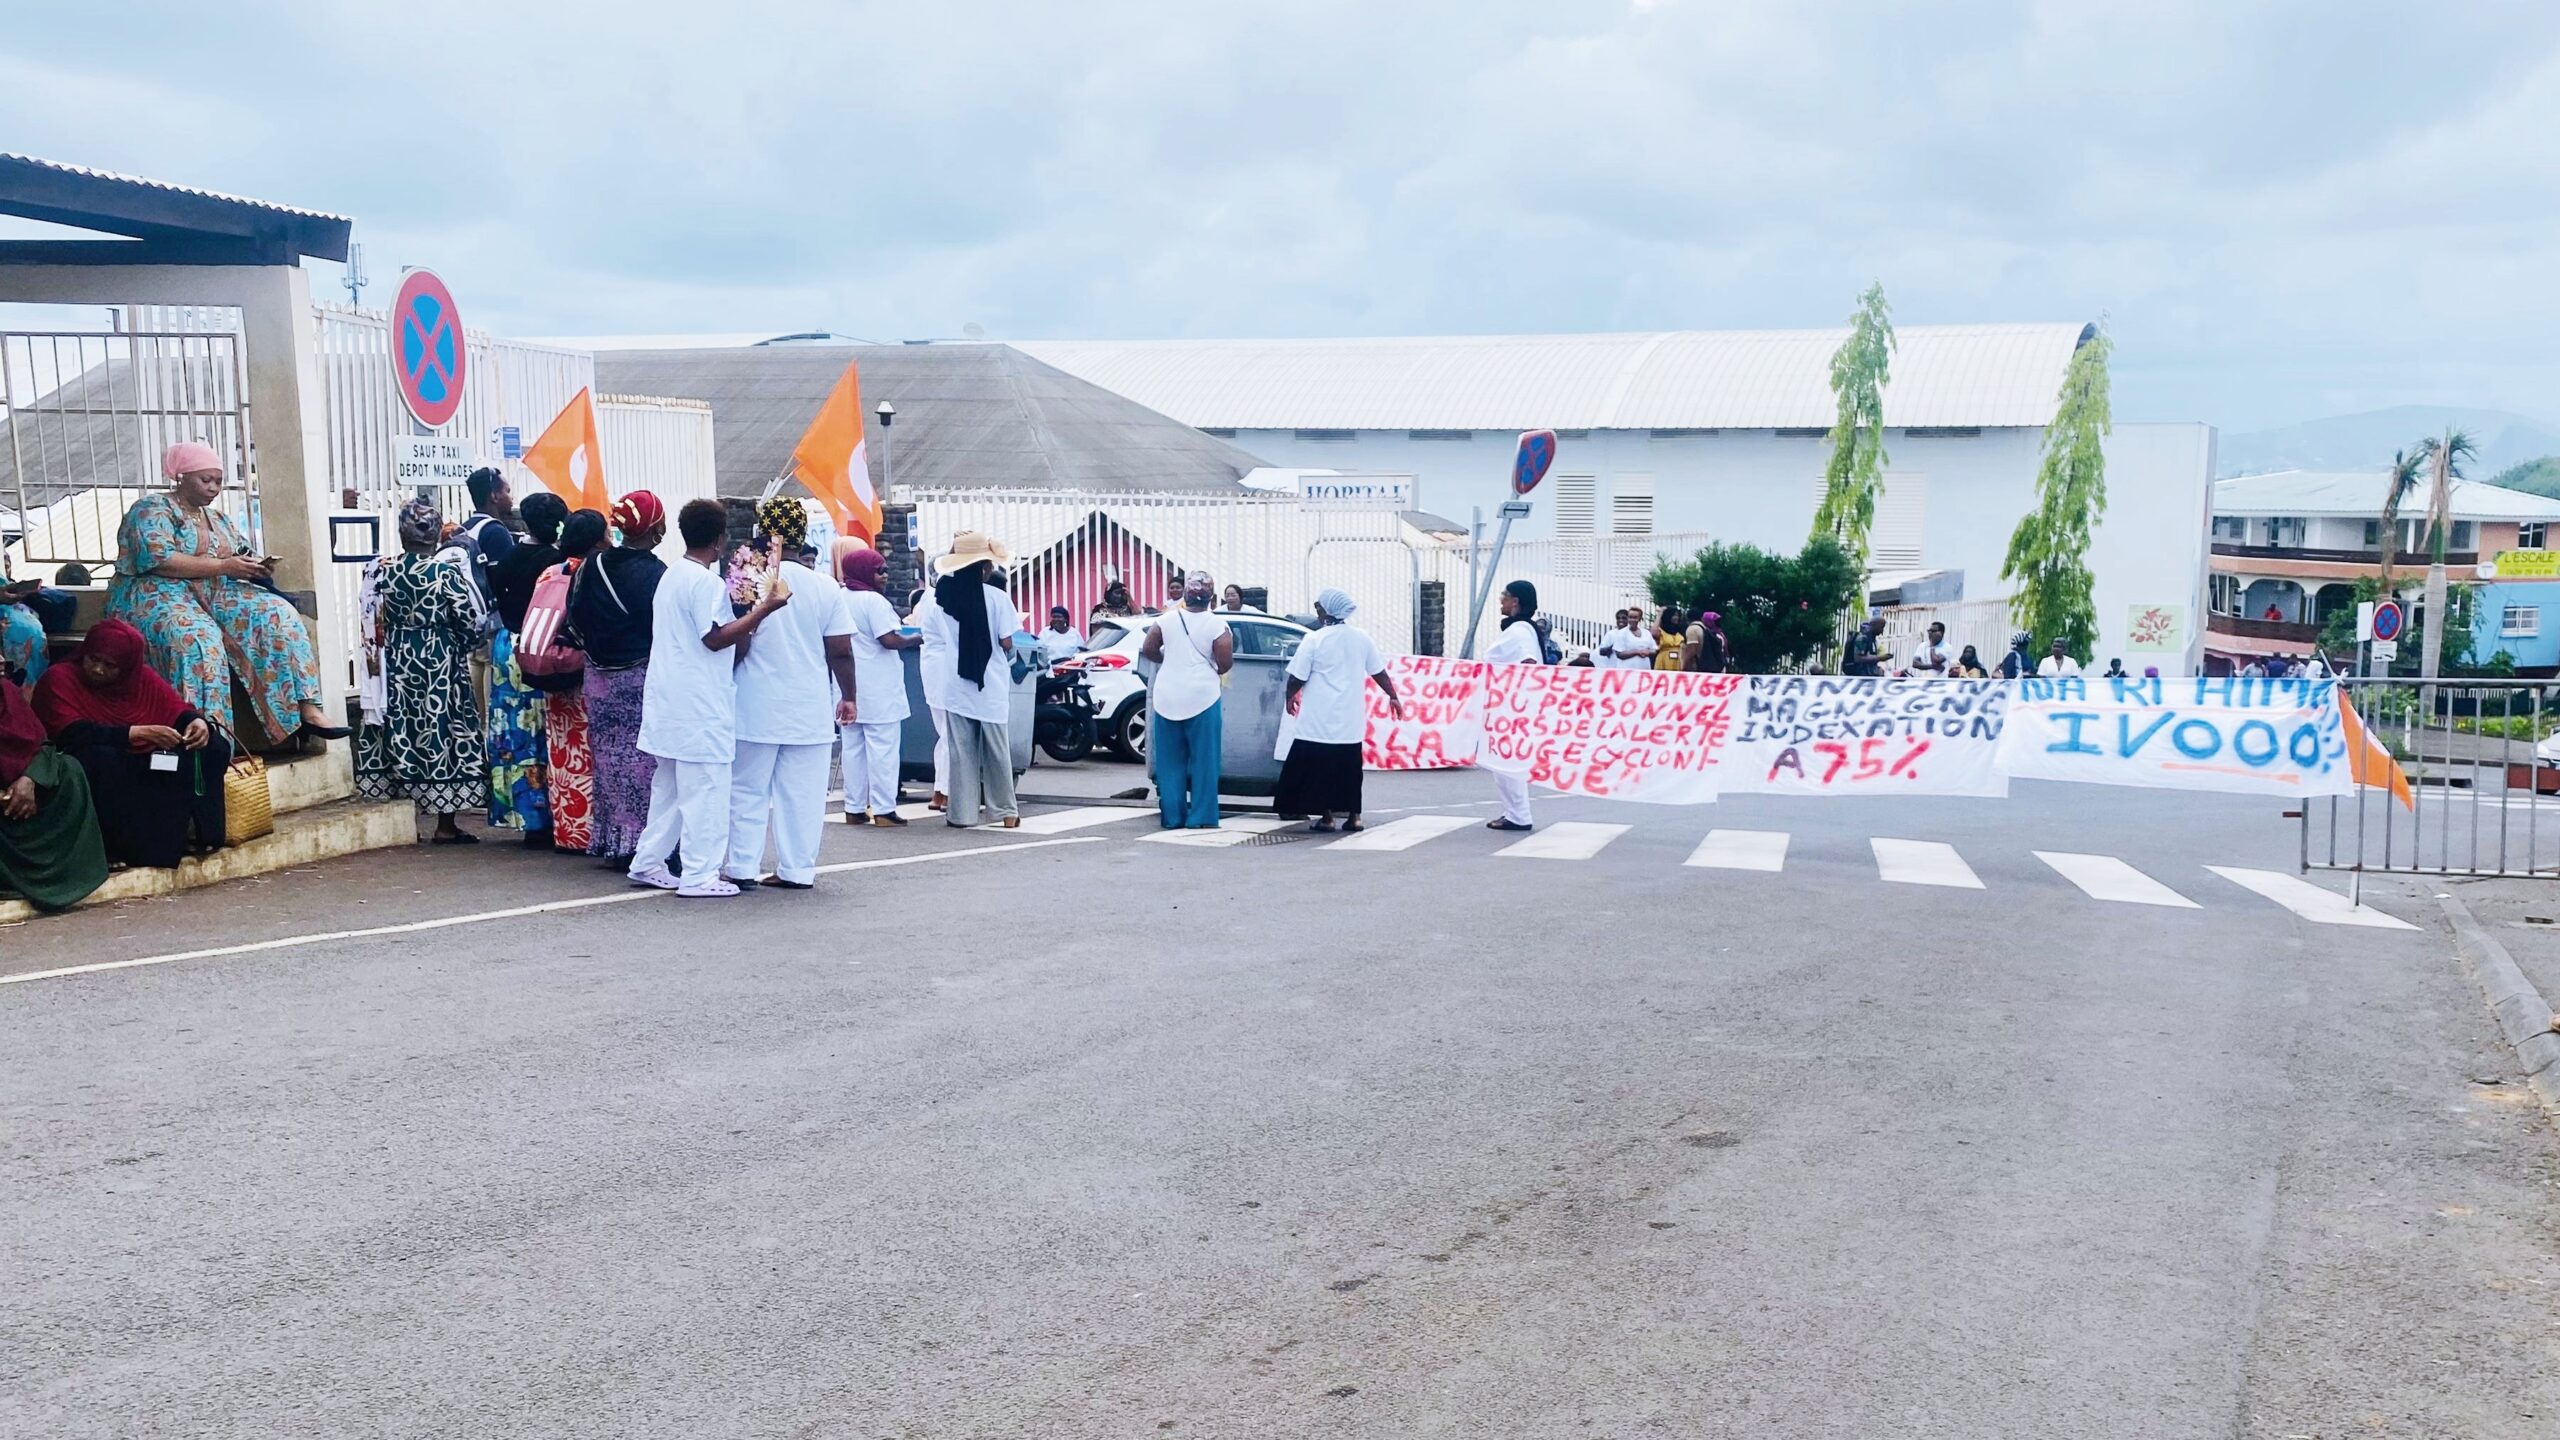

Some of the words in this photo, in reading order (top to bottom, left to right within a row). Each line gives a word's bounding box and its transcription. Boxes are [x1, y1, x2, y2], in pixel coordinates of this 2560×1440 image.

[413, 444, 436, 459] SAUF
[441, 445, 460, 459] TAXI
[2505, 552, 2555, 563] L'ESCALE
[1483, 688, 1529, 713] DU
[1539, 693, 1730, 724] PERSONNEL
[1736, 715, 2004, 745] INDEXATION
[1489, 734, 1587, 764] ROUGE
[1767, 747, 1805, 782] A
[1813, 735, 1931, 784] 75%
